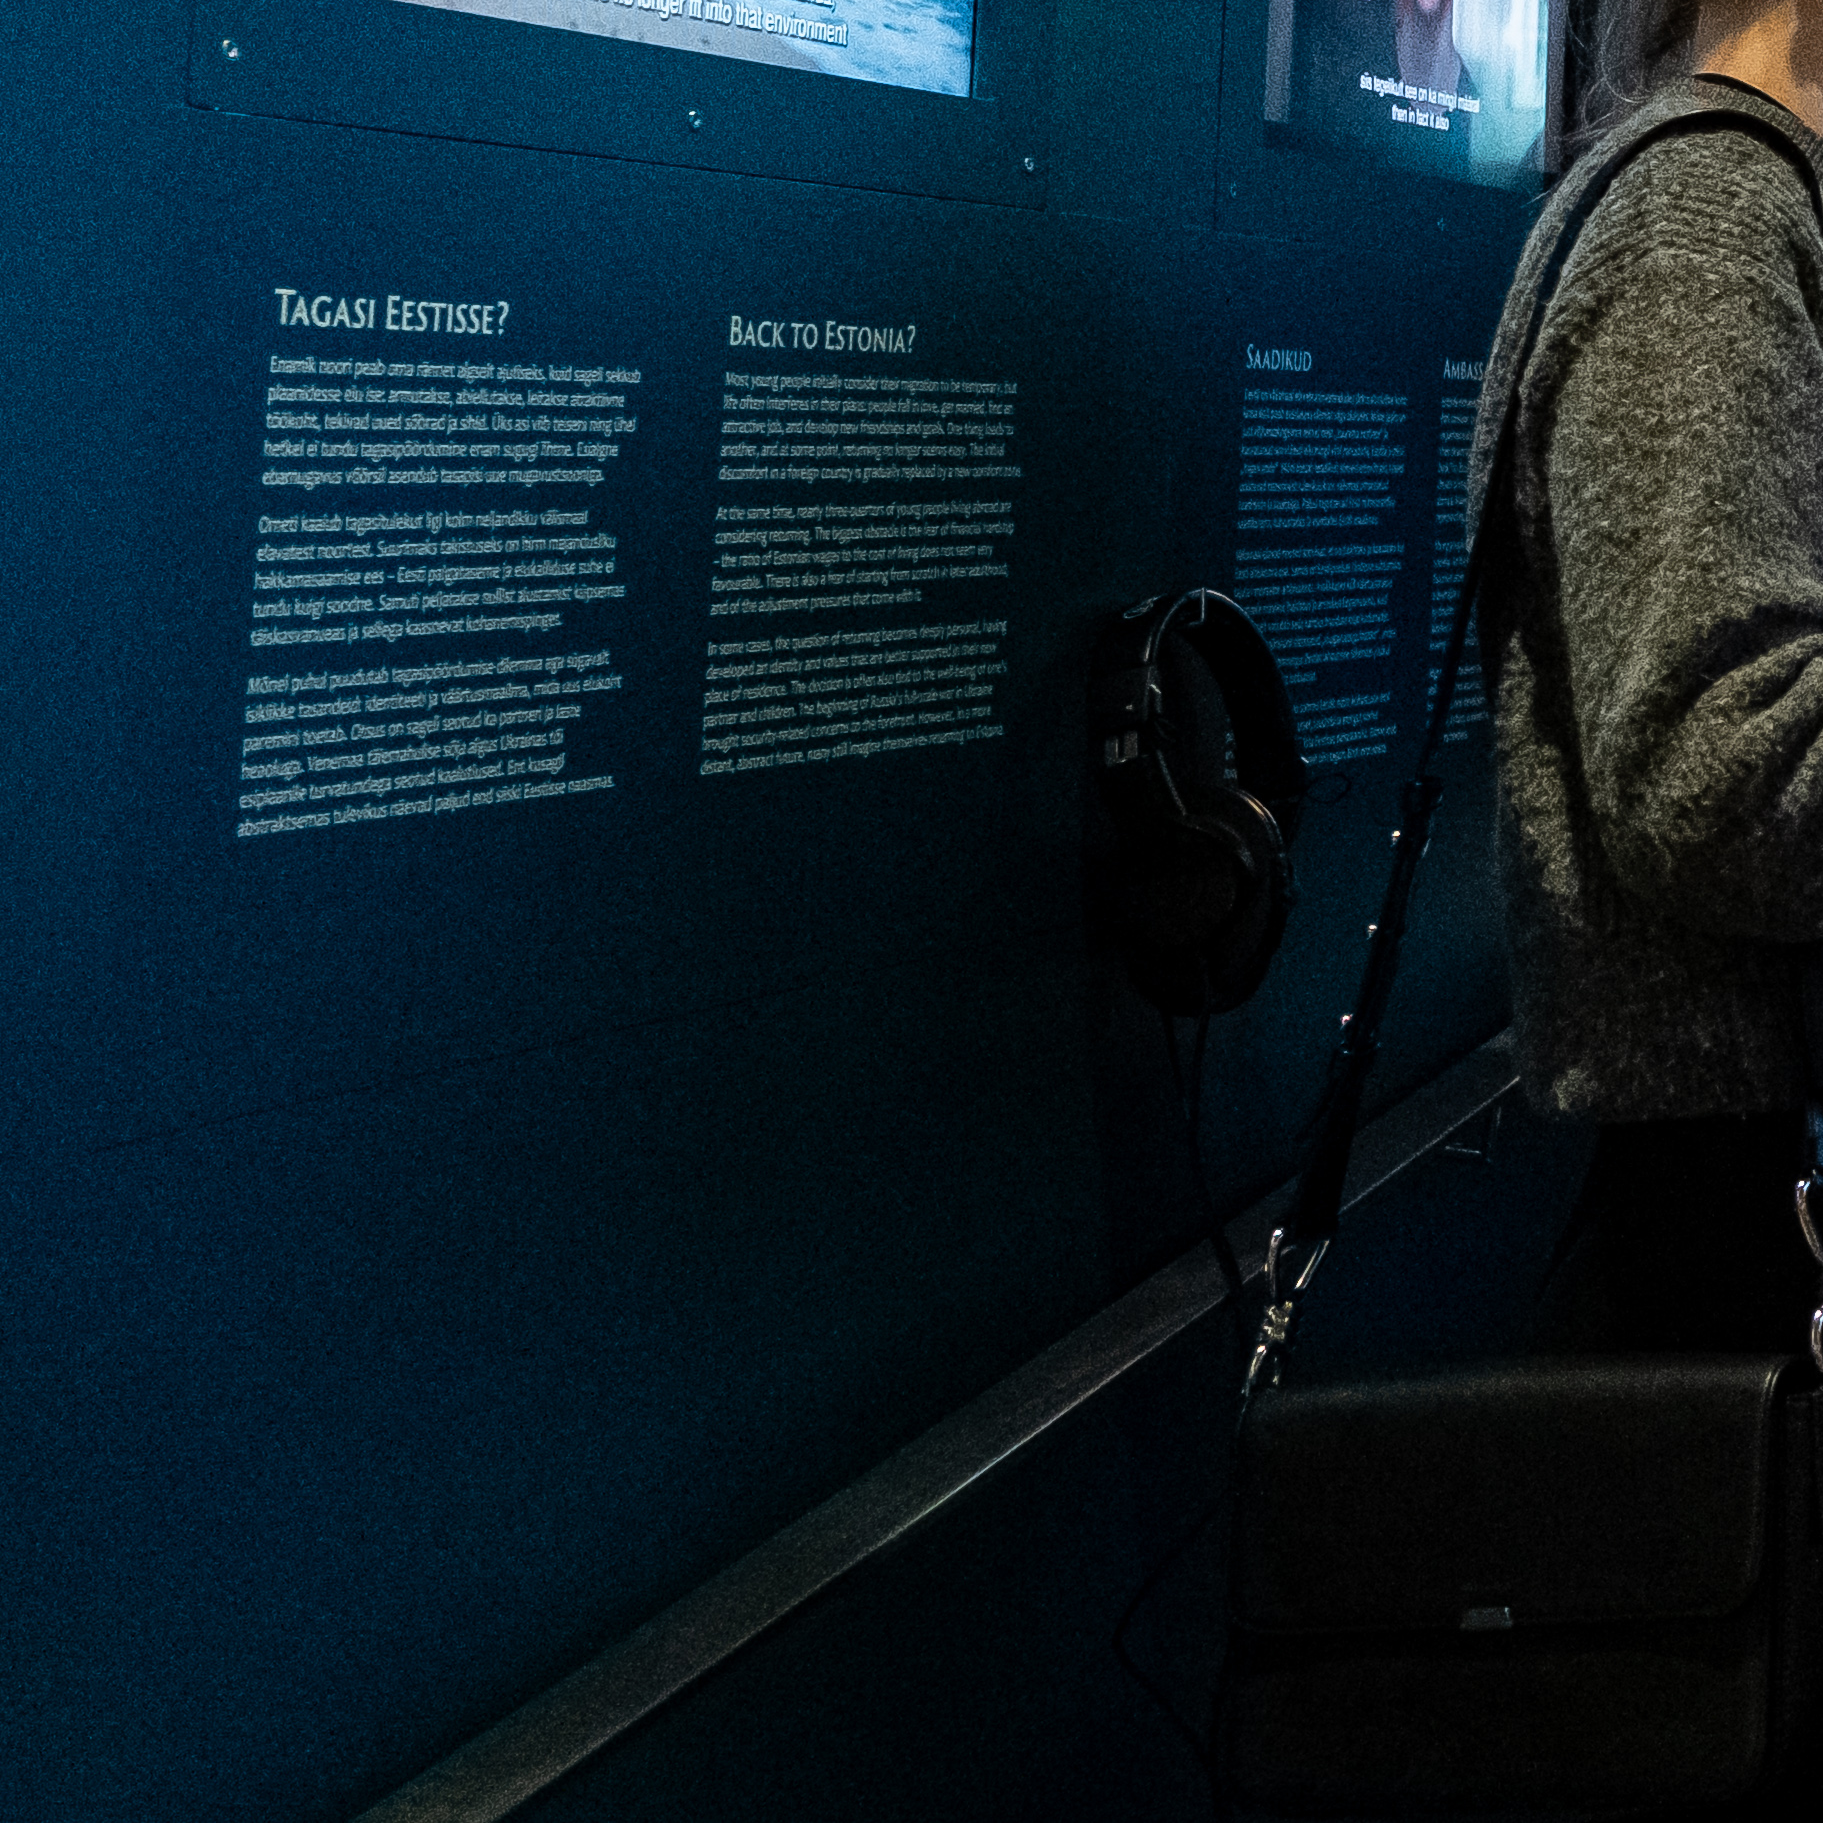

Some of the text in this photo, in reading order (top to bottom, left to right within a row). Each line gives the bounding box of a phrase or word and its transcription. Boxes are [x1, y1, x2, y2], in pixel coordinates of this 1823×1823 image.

[735, 2, 763, 31] that
[764, 11, 848, 46] environment
[1405, 84, 1417, 101] see
[1418, 87, 1427, 102] on
[1392, 104, 1408, 123] then
[1408, 107, 1416, 124] in
[274, 288, 510, 336] TAGASI EESTISSE?
[729, 315, 916, 353] BACK TO ESTONIA?
[1246, 343, 1312, 372] SAADIKUD
[1443, 357, 1485, 381] AMBASS
